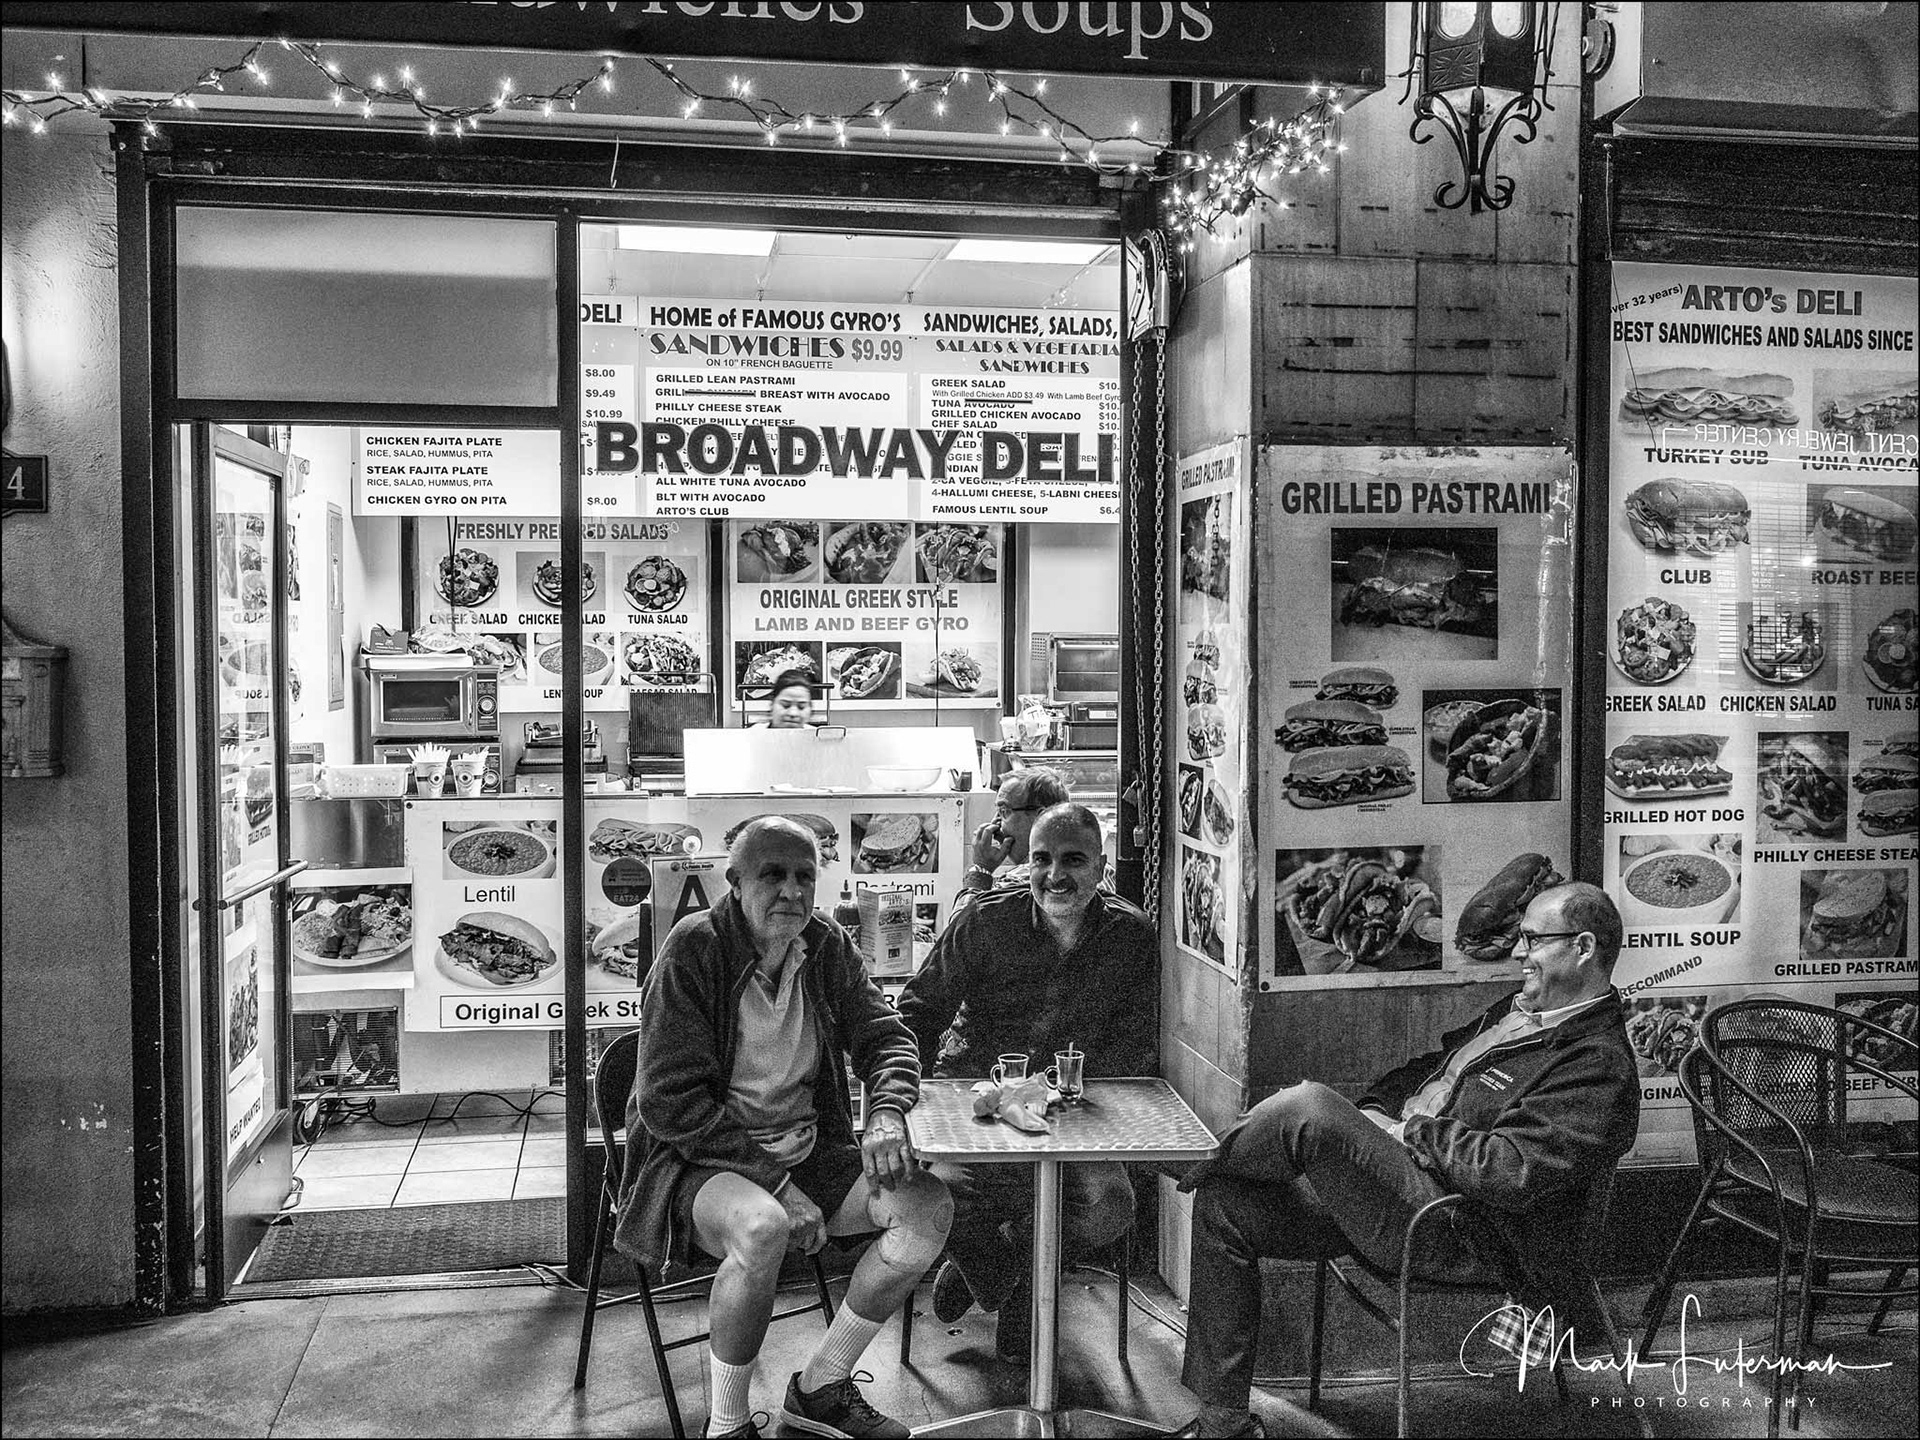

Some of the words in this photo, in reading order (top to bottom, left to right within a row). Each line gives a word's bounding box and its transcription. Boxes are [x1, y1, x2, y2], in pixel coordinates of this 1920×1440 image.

[1631, 294, 1647, 307] 32
[1648, 283, 1683, 304] years)
[1681, 285, 1788, 314] ARTO's
[1797, 288, 1863, 316] DELI
[581, 303, 622, 324] DELI
[650, 306, 712, 327] HOME
[718, 308, 737, 328] of
[742, 309, 825, 330] FAMOUS
[830, 312, 901, 332] GYRO'S
[924, 312, 1045, 336] SANDWICHES,
[1049, 316, 1118, 339] SALADS,
[1613, 320, 1654, 343] BEST
[1658, 322, 1762, 347] SANDWICHES
[1766, 326, 1799, 348] AND
[1803, 327, 1863, 350] SALADS
[1868, 330, 1913, 351] SINCE
[650, 333, 845, 358] SANDWICHES
[851, 338, 903, 362] $9.99
[936, 339, 1003, 354] SALADS
[1006, 340, 1020, 354] &
[706, 358, 721, 367] ON
[723, 358, 739, 368] 10"
[740, 359, 780, 368] FRENCH
[782, 360, 833, 370] BAGUETTE
[979, 359, 1090, 375] SANDWICHES
[585, 368, 616, 378] $8.00
[656, 374, 704, 384] GRILLED
[707, 375, 736, 384] LEAN
[740, 376, 796, 386] PASTRAMI
[931, 379, 970, 388] GREEK
[971, 380, 1006, 388] SALAD
[585, 389, 616, 398] $9.49
[760, 390, 804, 400] BREAST
[806, 391, 835, 400] WITH
[838, 392, 890, 401] AVOCADO
[932, 390, 948, 398] With
[950, 390, 975, 398] Grilled
[976, 390, 1005, 399] Chicken
[1024, 392, 1044, 400] $3.49
[1047, 392, 1064, 400] With
[1064, 392, 1084, 401] Lamb
[1086, 393, 1103, 401] Beef
[655, 402, 695, 412] PHILLY
[698, 404, 742, 413] CHEESE
[745, 404, 782, 414] STEAK
[931, 400, 961, 408] TUNA
[585, 409, 622, 419] $10.99
[931, 410, 977, 419] GRILLED
[980, 410, 1028, 420] CHICKEN
[1031, 412, 1082, 420] AVOCADO
[931, 420, 960, 428] CHEF
[962, 420, 998, 429] SALAD
[366, 436, 420, 446] CHICKEN
[424, 437, 462, 446] FAJITA
[466, 438, 502, 447] PLATE
[366, 450, 392, 459] RICE,
[394, 450, 426, 459] SALAD,
[428, 450, 471, 459] HUMMUS,
[473, 450, 494, 458] PITA
[597, 420, 963, 481] BROADWAY
[981, 430, 1114, 484] DELI
[1644, 448, 1724, 465] TURKEY
[1729, 450, 1769, 465] SUB
[1799, 455, 1852, 471] TUNA
[366, 466, 406, 475] STEAK
[409, 466, 448, 476] FAJITA
[452, 466, 488, 476] PLATE
[7, 465, 25, 500] 4
[366, 478, 392, 488] RICE,
[394, 479, 426, 488] SALAD,
[428, 479, 471, 488] HUMMUS,
[473, 480, 494, 488] PITA
[656, 478, 677, 486] ALL
[680, 478, 716, 487] WHITE
[720, 478, 750, 487] TUNA
[753, 478, 807, 488] AVOCADO
[367, 496, 421, 505] CHICKEN
[424, 496, 458, 505] GYRO
[460, 496, 478, 505] ON
[481, 496, 508, 505] PITA
[656, 494, 678, 502] BLT
[680, 494, 710, 502] WITH
[712, 494, 766, 503] AVOCADO
[931, 489, 988, 498] 4-HALLUMI
[990, 490, 1036, 500] CHEESE,
[1040, 490, 1080, 498] 5-LABNI
[1281, 481, 1402, 515] GRILLED
[1412, 481, 1551, 514] PASTRAMI
[656, 507, 697, 516] ARTO'S
[700, 508, 730, 516] CLUB
[932, 506, 976, 514] FAMOUS
[980, 506, 1018, 515] LENTIL
[1020, 506, 1048, 515] SOUP
[458, 523, 524, 540] FRESHLY
[610, 524, 669, 540] SALADS
[1660, 568, 1712, 585] CLUB
[1811, 570, 1874, 586] ROAST
[760, 588, 840, 610] ORIGINAL
[845, 589, 902, 610] GREEK
[906, 589, 958, 609] STYLE
[628, 614, 654, 625] TUNA
[656, 614, 688, 625] SALAD
[754, 617, 809, 632] LAMB
[814, 617, 856, 632] AND
[861, 617, 910, 632] BEEF
[915, 617, 970, 632] GYRO
[1605, 695, 1653, 712] GREEK
[1657, 695, 1706, 712] SALAD
[1720, 696, 1786, 712] CHICKEN
[1789, 695, 1838, 712] SALAD
[1866, 696, 1901, 711] TUNA
[1604, 810, 1669, 824] GRILLED
[1674, 810, 1708, 823] HOT
[1712, 808, 1745, 822] DOG
[1754, 850, 1808, 863] PHILLY
[1813, 849, 1876, 862] CHEESE
[464, 885, 516, 902] Lentil
[1690, 930, 1742, 947] SOUP
[1620, 955, 1703, 999] RECOMMAND
[1774, 962, 1842, 977] GRILLED
[454, 1000, 540, 1024] Original
